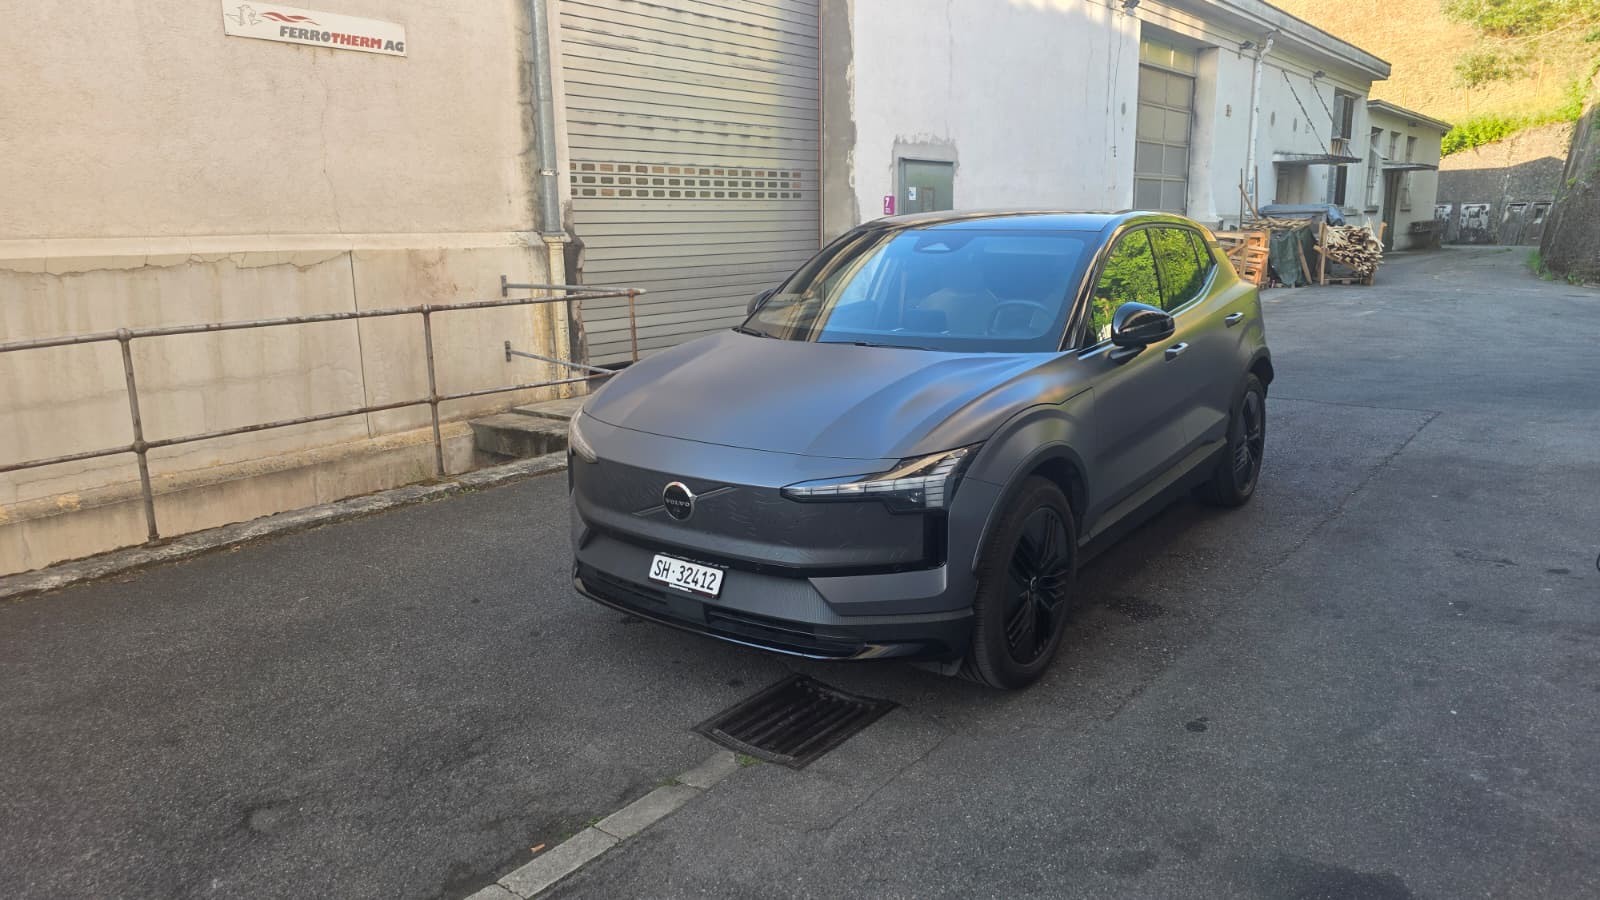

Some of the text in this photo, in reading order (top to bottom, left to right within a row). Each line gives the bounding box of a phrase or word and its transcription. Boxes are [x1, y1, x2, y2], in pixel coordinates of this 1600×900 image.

[279, 25, 405, 52] FERROTHERM AG
[665, 498, 690, 508] VOLVO
